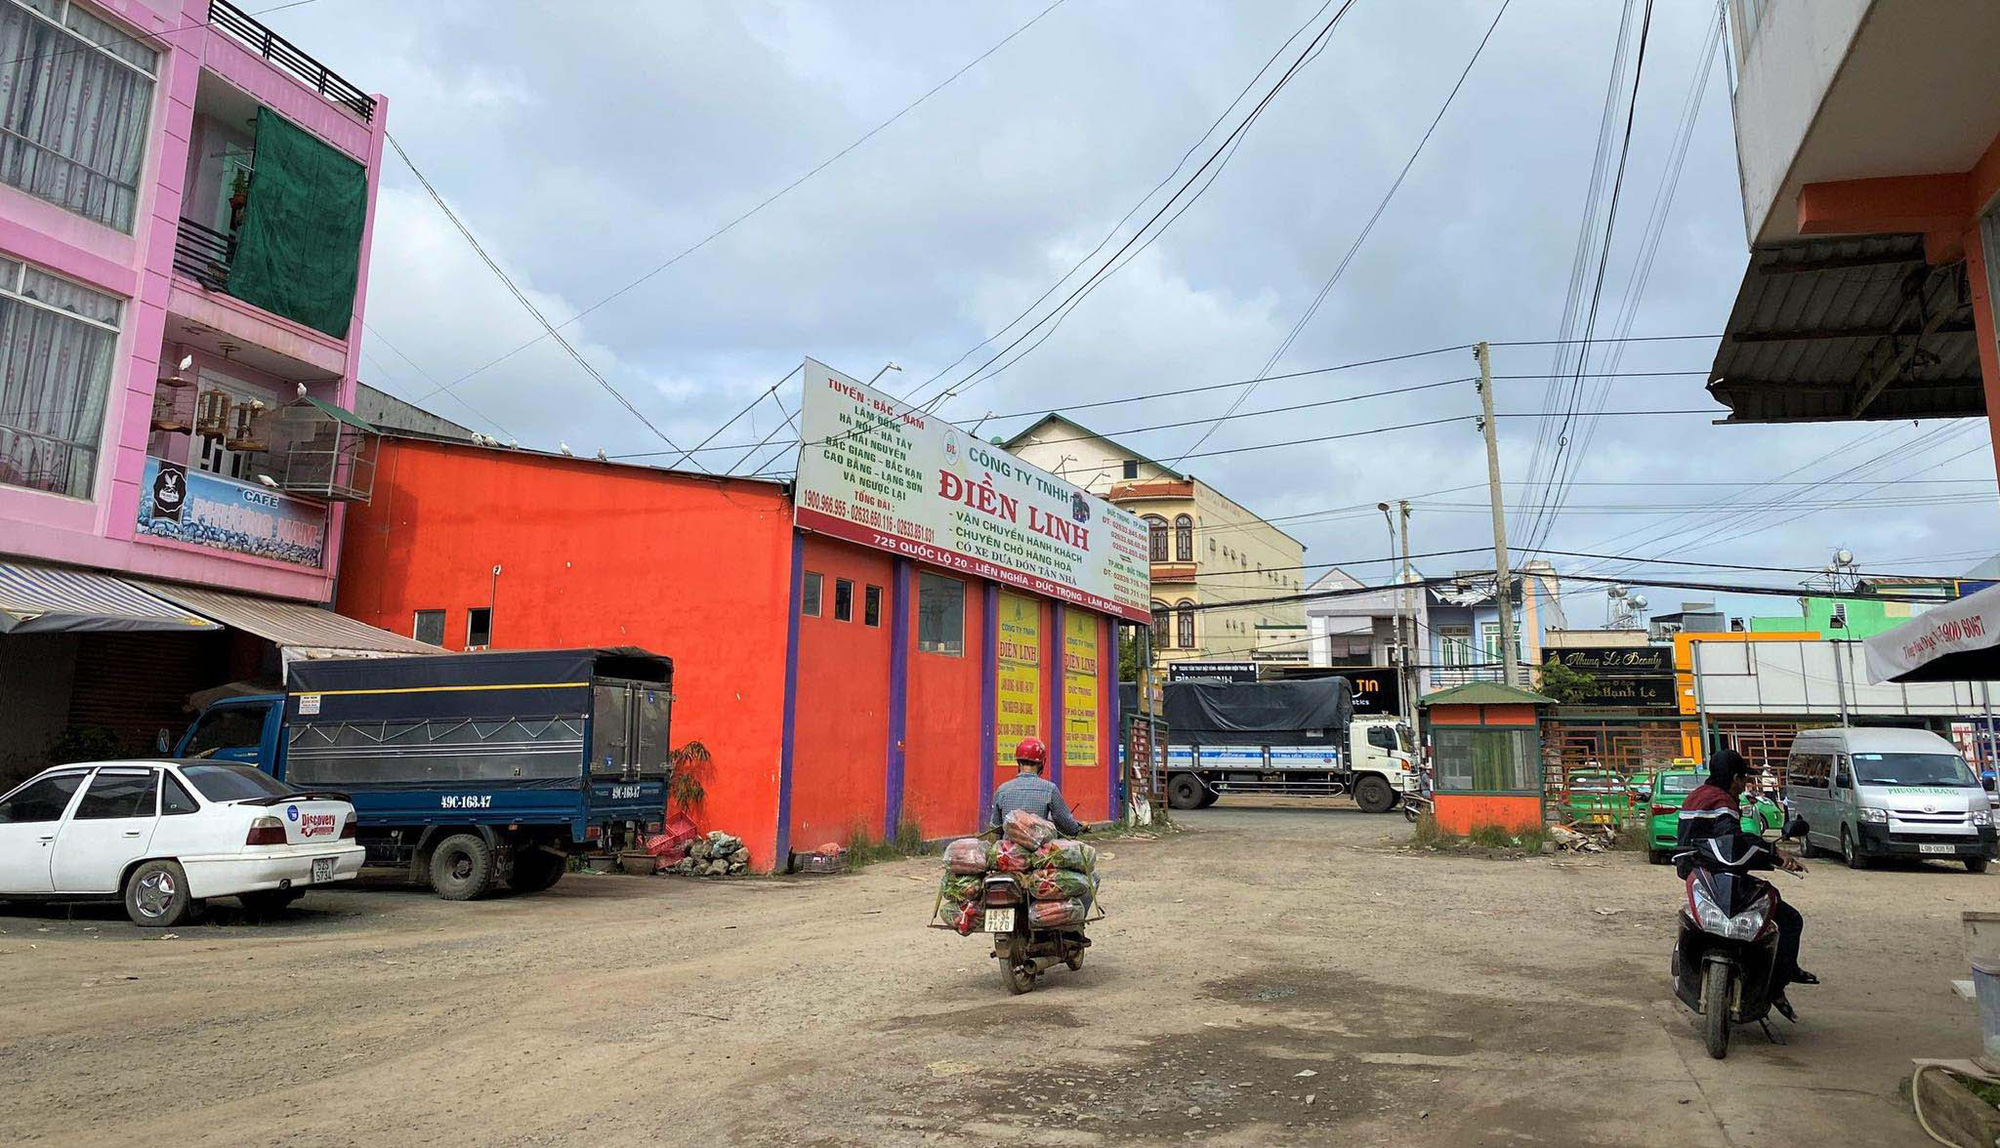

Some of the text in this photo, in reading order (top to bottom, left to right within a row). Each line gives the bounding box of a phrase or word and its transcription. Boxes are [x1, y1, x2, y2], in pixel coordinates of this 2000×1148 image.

[828, 377, 925, 430] TUYẾN BẮC NAM
[854, 405, 875, 421] LÂM
[839, 412, 853, 426] HÀ
[881, 430, 893, 442] HÀ
[895, 436, 913, 451] TÂY
[826, 436, 923, 480] BẮC GIANG BẮC KẠN
[870, 440, 906, 461] NGUYÊN
[823, 449, 844, 465] CAO
[881, 471, 904, 487] LẠNG
[906, 481, 923, 493] SƠN
[843, 471, 856, 483] VÀ
[892, 491, 906, 501] LẠI
[969, 447, 1069, 504] CÔNG TY TNHH
[854, 488, 875, 506] TỔNG
[938, 469, 1090, 552] ĐIỀN LINH
[955, 526, 1001, 549] CHUYÊN
[1026, 549, 1052, 567] HÀNG
[956, 510, 1083, 563] VẬN CHUYỂN HÀNH KHÁCH
[956, 540, 972, 552] CÓ
[975, 548, 989, 558] XE
[873, 534, 896, 549] 725
[900, 541, 935, 559] QUỐC
[937, 551, 952, 566] LỘ
[954, 557, 968, 568] 20
[975, 562, 998, 577] LIÊN
[1000, 569, 1029, 586] NGHĨA
[1036, 580, 1054, 592] ĐỨC
[1056, 586, 1083, 602] TRỌNG
[1088, 596, 1103, 608] LÂM
[1938, 620, 1962, 642] 1900
[1961, 615, 1985, 639] 6067
[1019, 644, 1037, 661] LINH
[441, 795, 492, 808] 49C-163.47
[301, 813, 336, 828] Discovery
[316, 870, 332, 881] 5734
